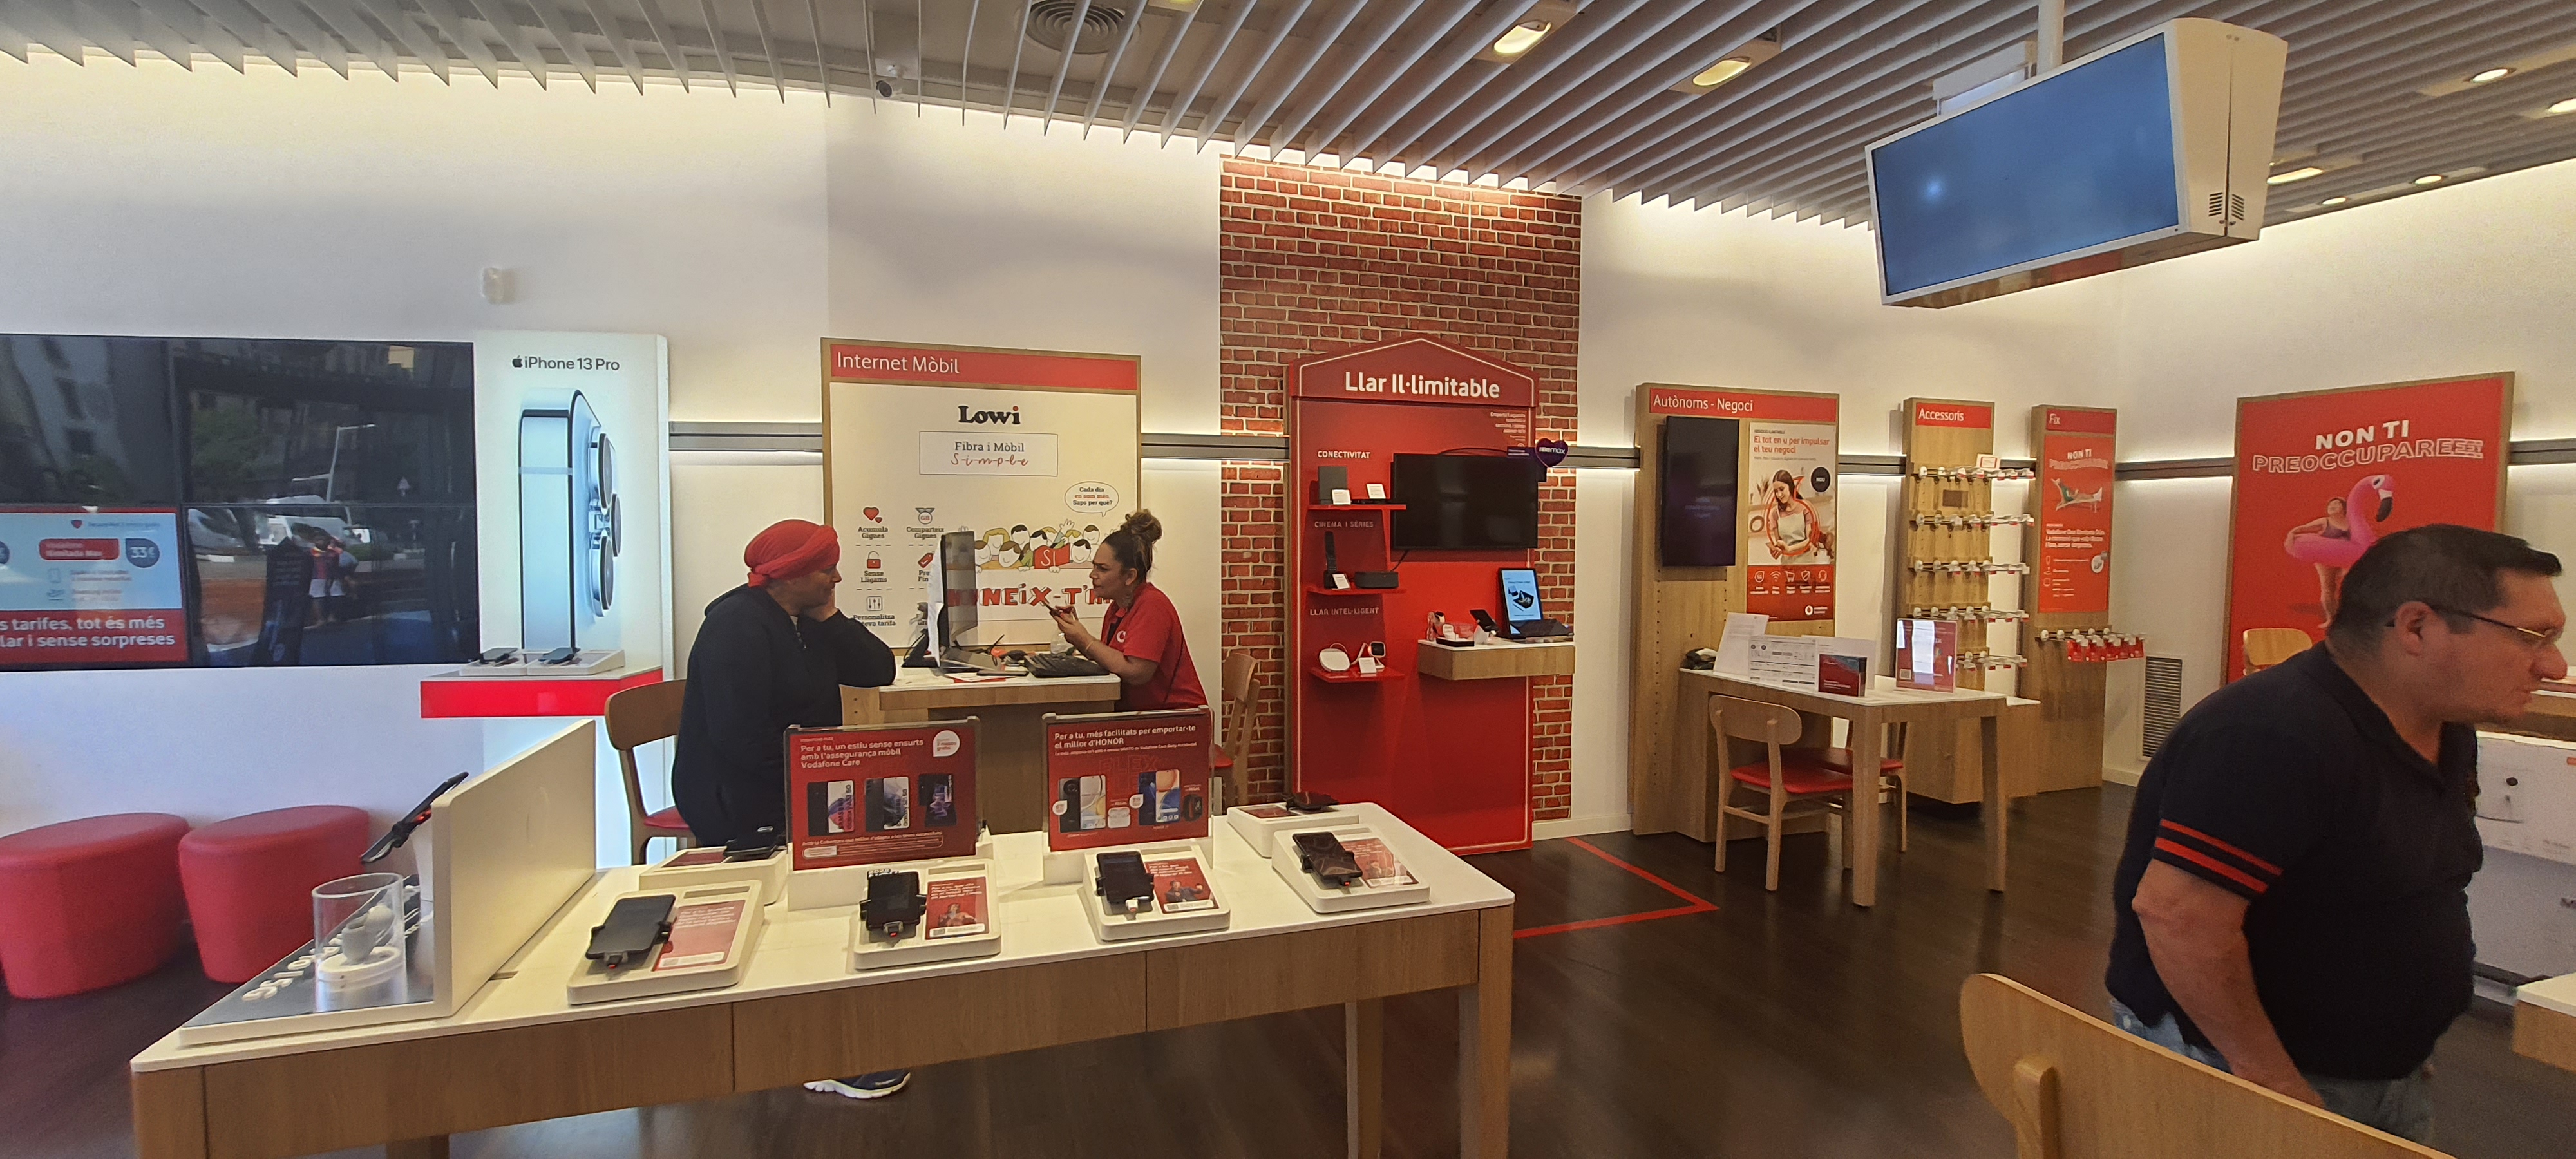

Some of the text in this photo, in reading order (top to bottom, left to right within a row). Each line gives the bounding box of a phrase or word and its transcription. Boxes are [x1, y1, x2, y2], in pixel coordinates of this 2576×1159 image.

[524, 356, 620, 370] iPhone 13 Pro
[838, 352, 960, 373] Internet Mòbil
[1345, 371, 1500, 398] Llar Il·limitable
[1653, 394, 1709, 410] Autònoms
[1717, 398, 1753, 413] Negoci
[958, 406, 1021, 424] Lowi
[2049, 413, 2060, 424] Fix
[2316, 420, 2409, 449] NON TI
[955, 441, 1025, 452] Fibra i Mòbil
[1801, 438, 1830, 446] impulsar
[1774, 446, 1795, 455] negoci
[77, 618, 101, 630] tot
[106, 616, 125, 629] és
[129, 616, 164, 629] més
[37, 637, 88, 647] sense
[92, 634, 175, 649] sorpreses
[1086, 730, 1103, 739] més
[1104, 728, 1137, 737] facilitats
[1152, 725, 1196, 735] emportar-te
[894, 739, 923, 748] ensurts
[1064, 740, 1086, 748] millor
[1088, 737, 1124, 747] d'HONOR
[821, 749, 876, 760] l'assegurança
[878, 748, 901, 757] mòbil
[801, 760, 840, 769] Vodafone
